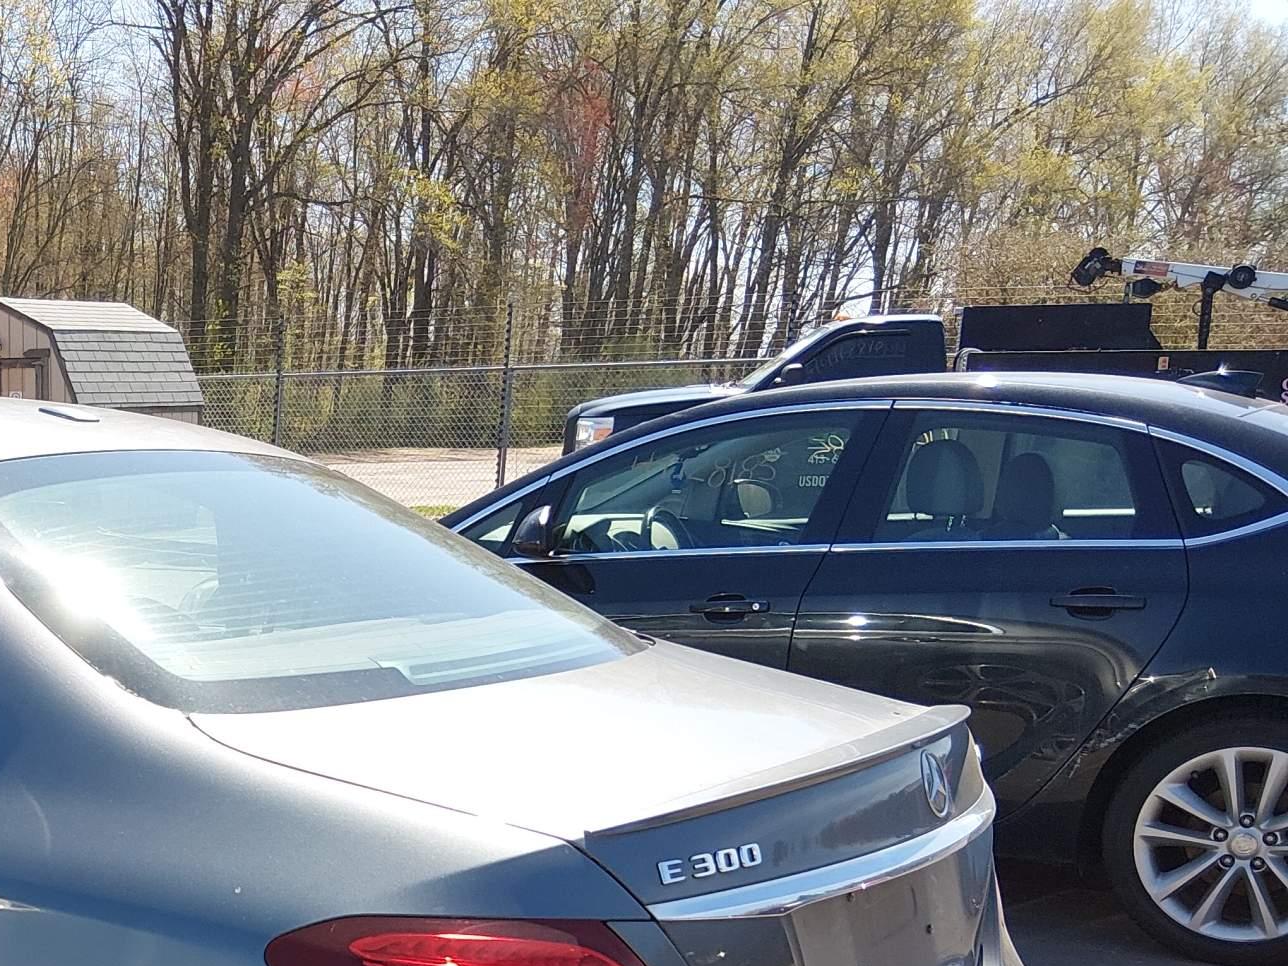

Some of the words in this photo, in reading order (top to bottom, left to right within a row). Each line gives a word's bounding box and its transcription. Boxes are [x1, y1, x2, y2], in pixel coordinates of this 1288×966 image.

[799, 475, 829, 487] USDO
[657, 859, 686, 885] E
[689, 843, 762, 878] 300
